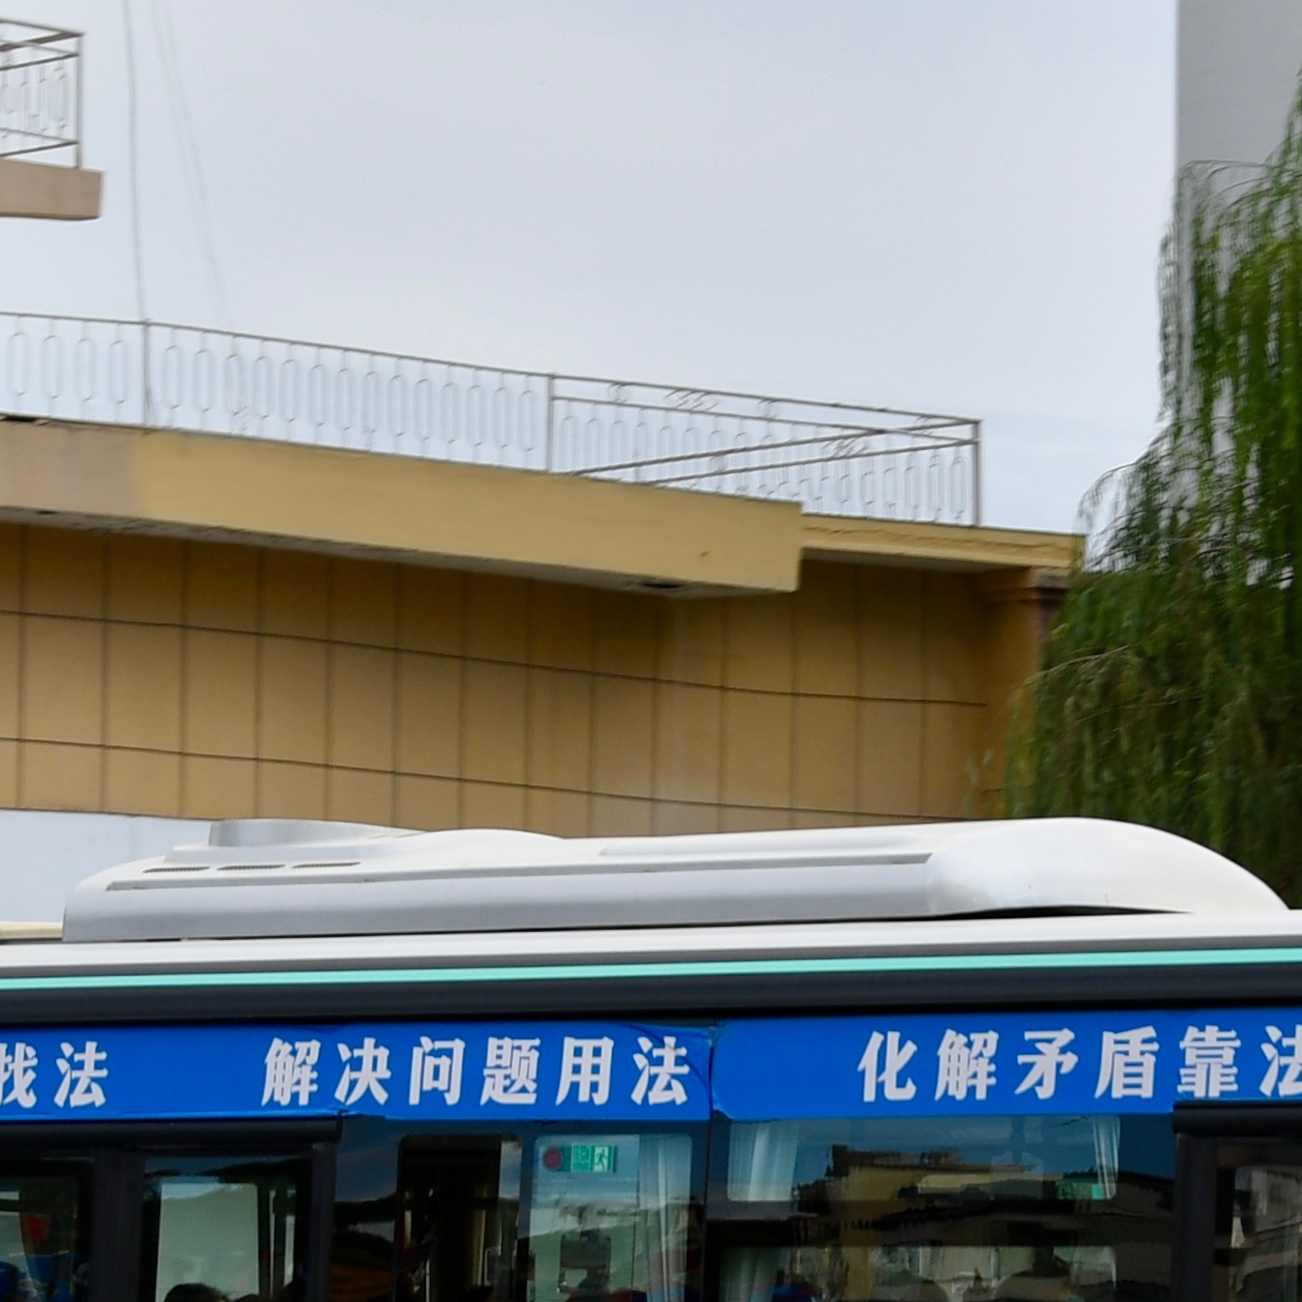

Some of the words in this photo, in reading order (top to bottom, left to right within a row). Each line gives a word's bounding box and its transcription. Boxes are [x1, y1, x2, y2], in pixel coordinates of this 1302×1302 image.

[260, 1035, 691, 1106] 解决问题用法
